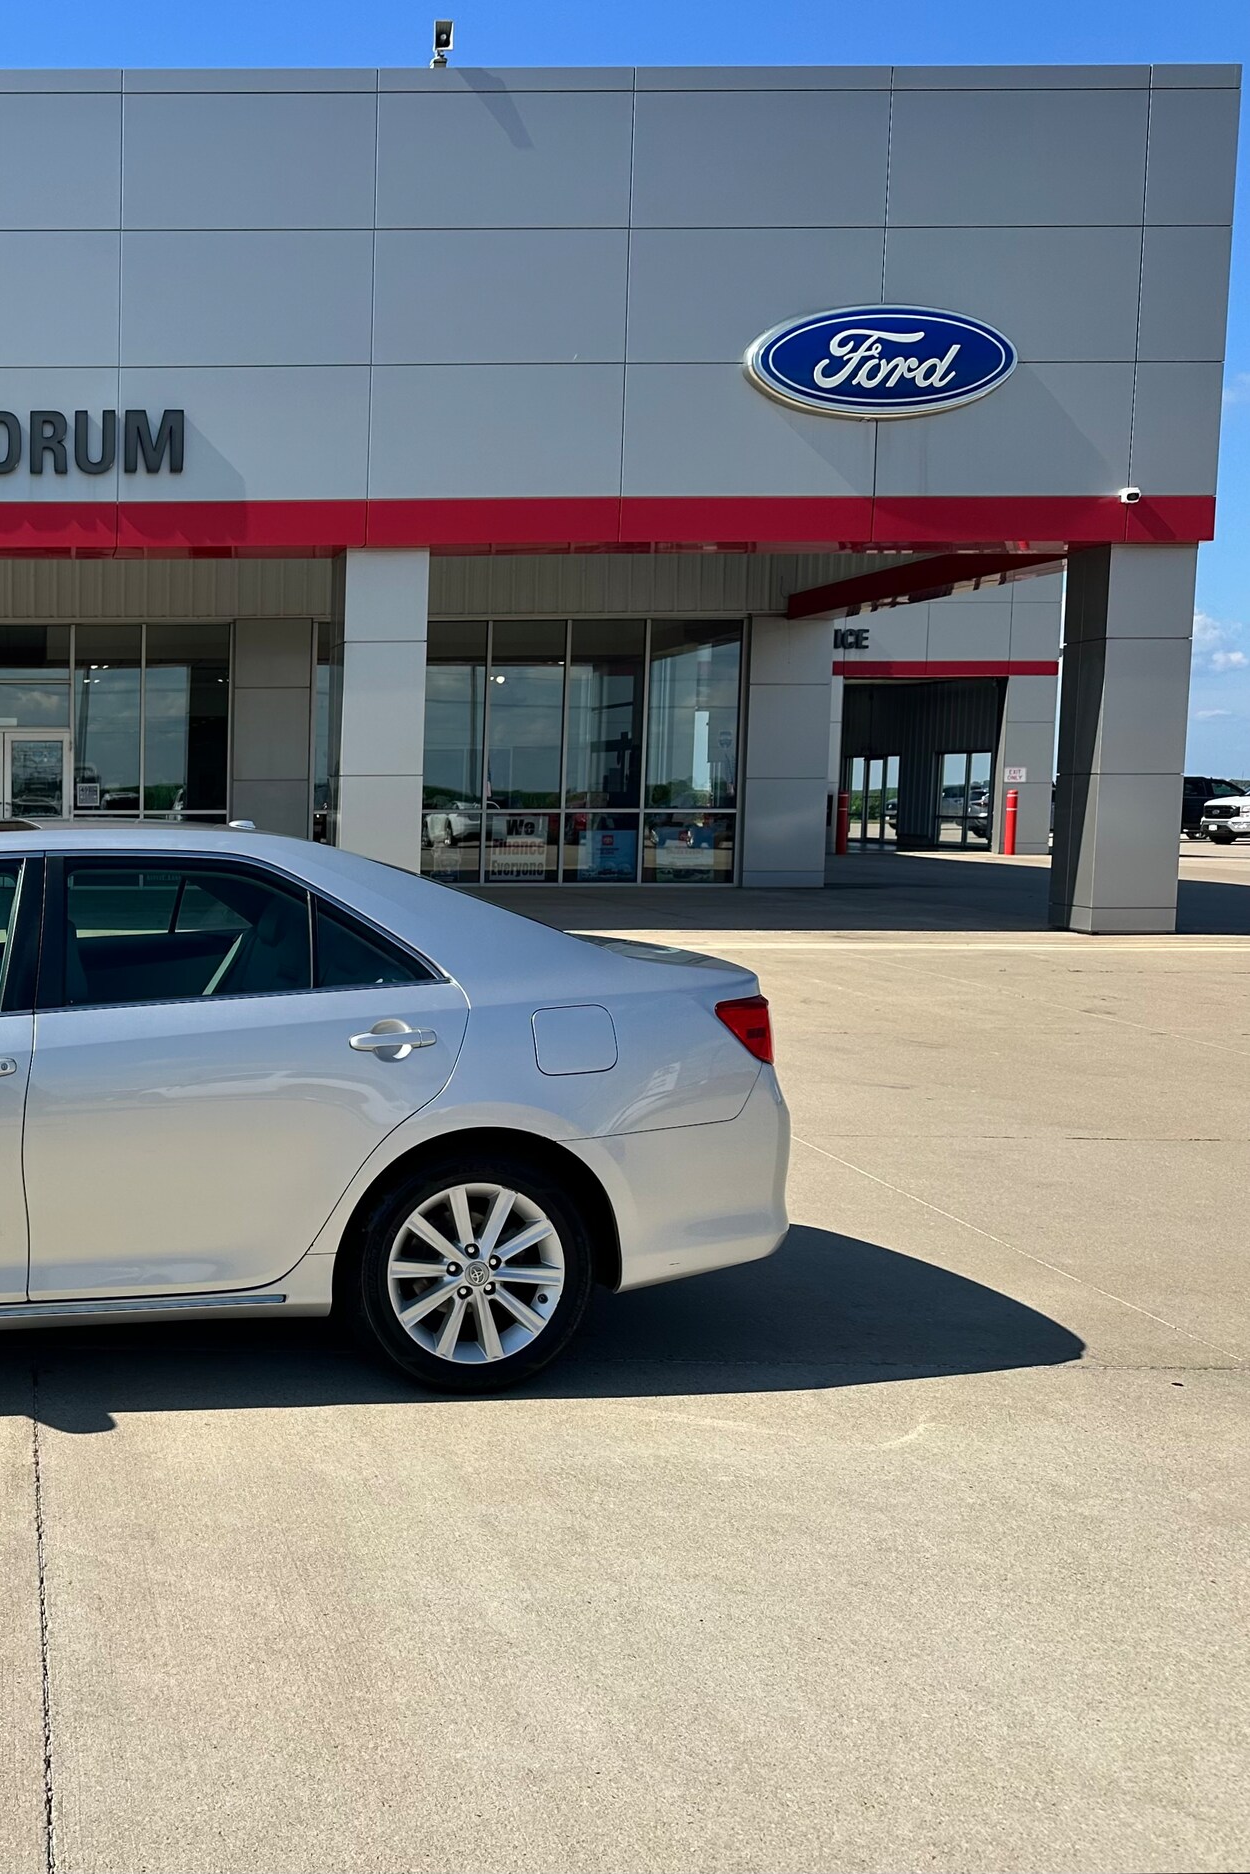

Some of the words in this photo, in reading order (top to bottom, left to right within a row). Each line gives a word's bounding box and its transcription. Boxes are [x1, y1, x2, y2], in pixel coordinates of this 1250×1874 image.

[813, 328, 962, 389] Ford
[506, 818, 536, 836] We
[492, 838, 545, 855] Finance
[491, 860, 545, 877] Everyone
